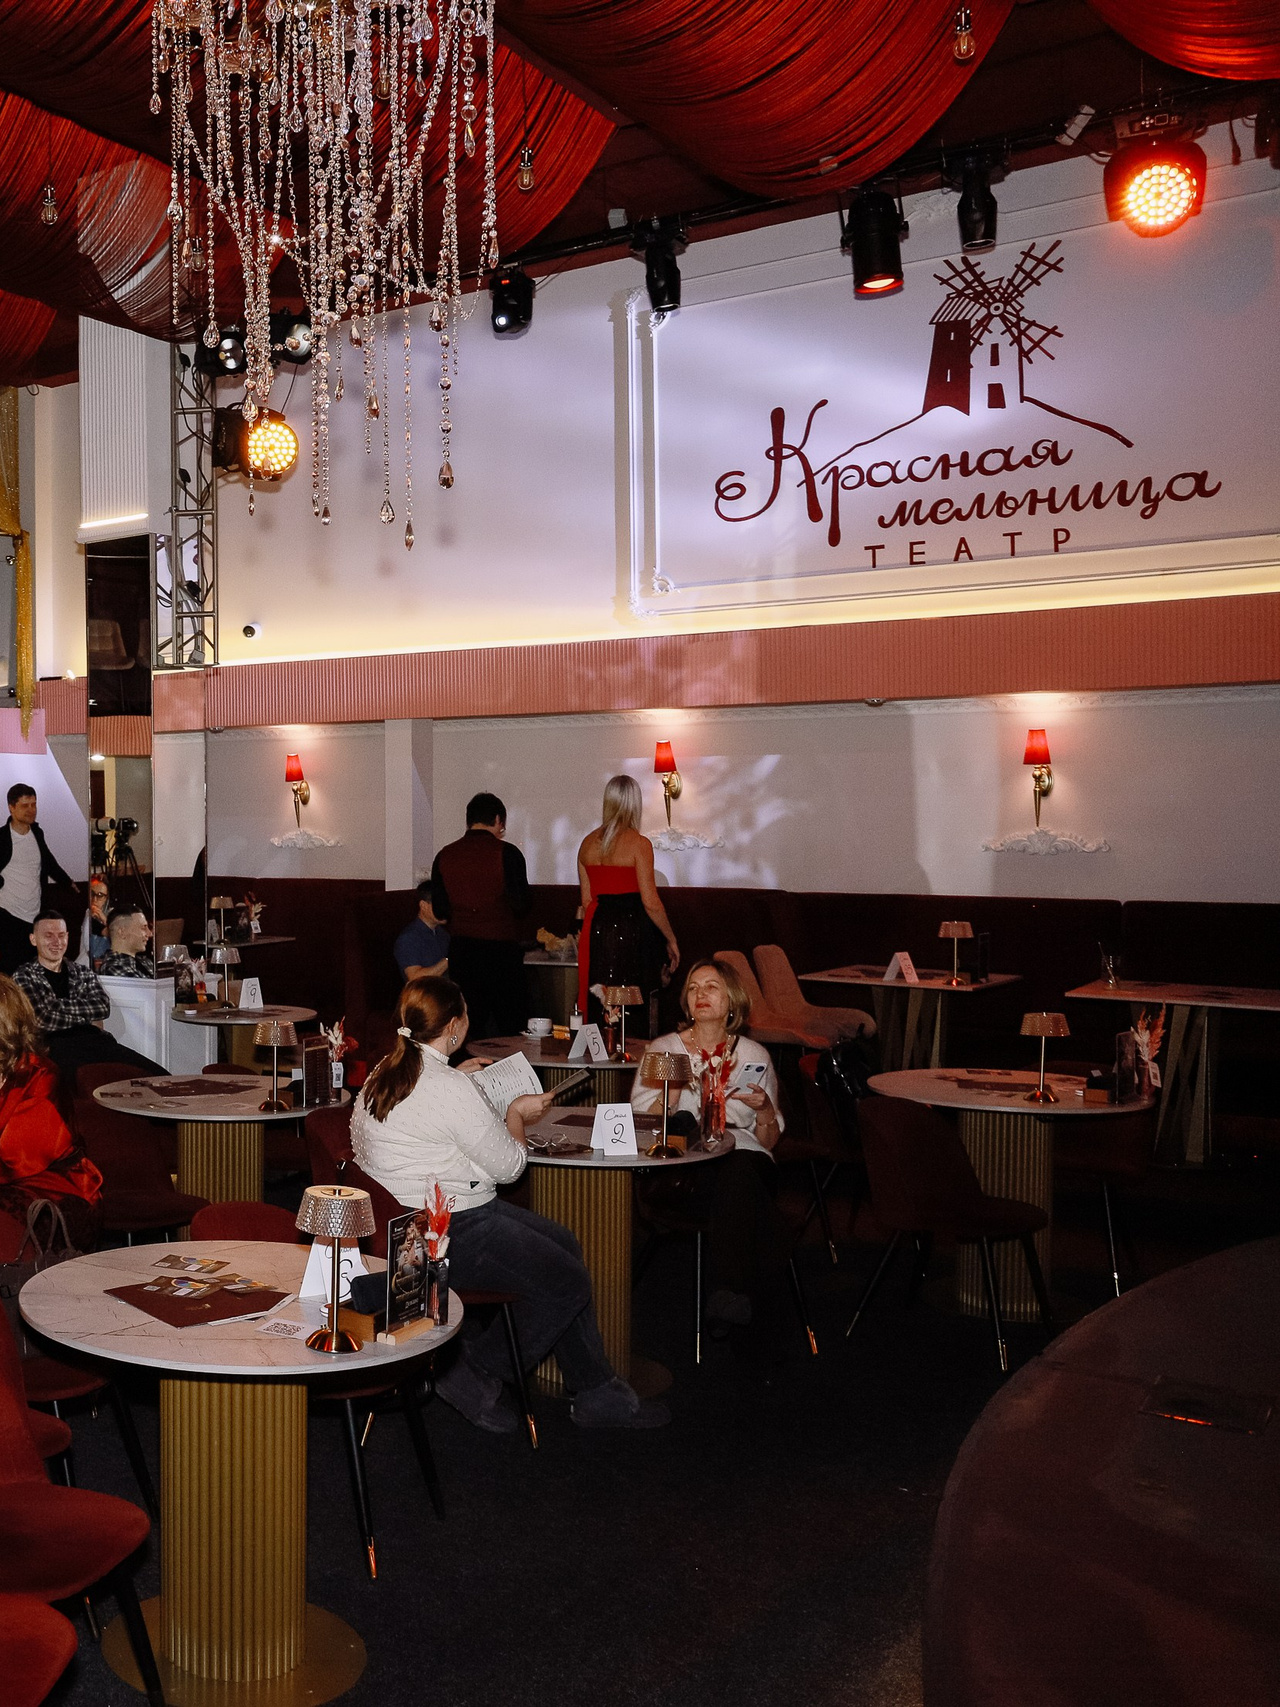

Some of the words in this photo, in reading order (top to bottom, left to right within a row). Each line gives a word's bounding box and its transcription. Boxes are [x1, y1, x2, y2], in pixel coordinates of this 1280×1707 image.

[714, 399, 1074, 547] Красная
[877, 470, 1222, 529] мельница
[864, 527, 1072, 569] ТЕАТР
[250, 987, 257, 1003] 9
[592, 1036, 601, 1056] 5
[611, 1122, 627, 1144] 2
[339, 1258, 353, 1298] 3
